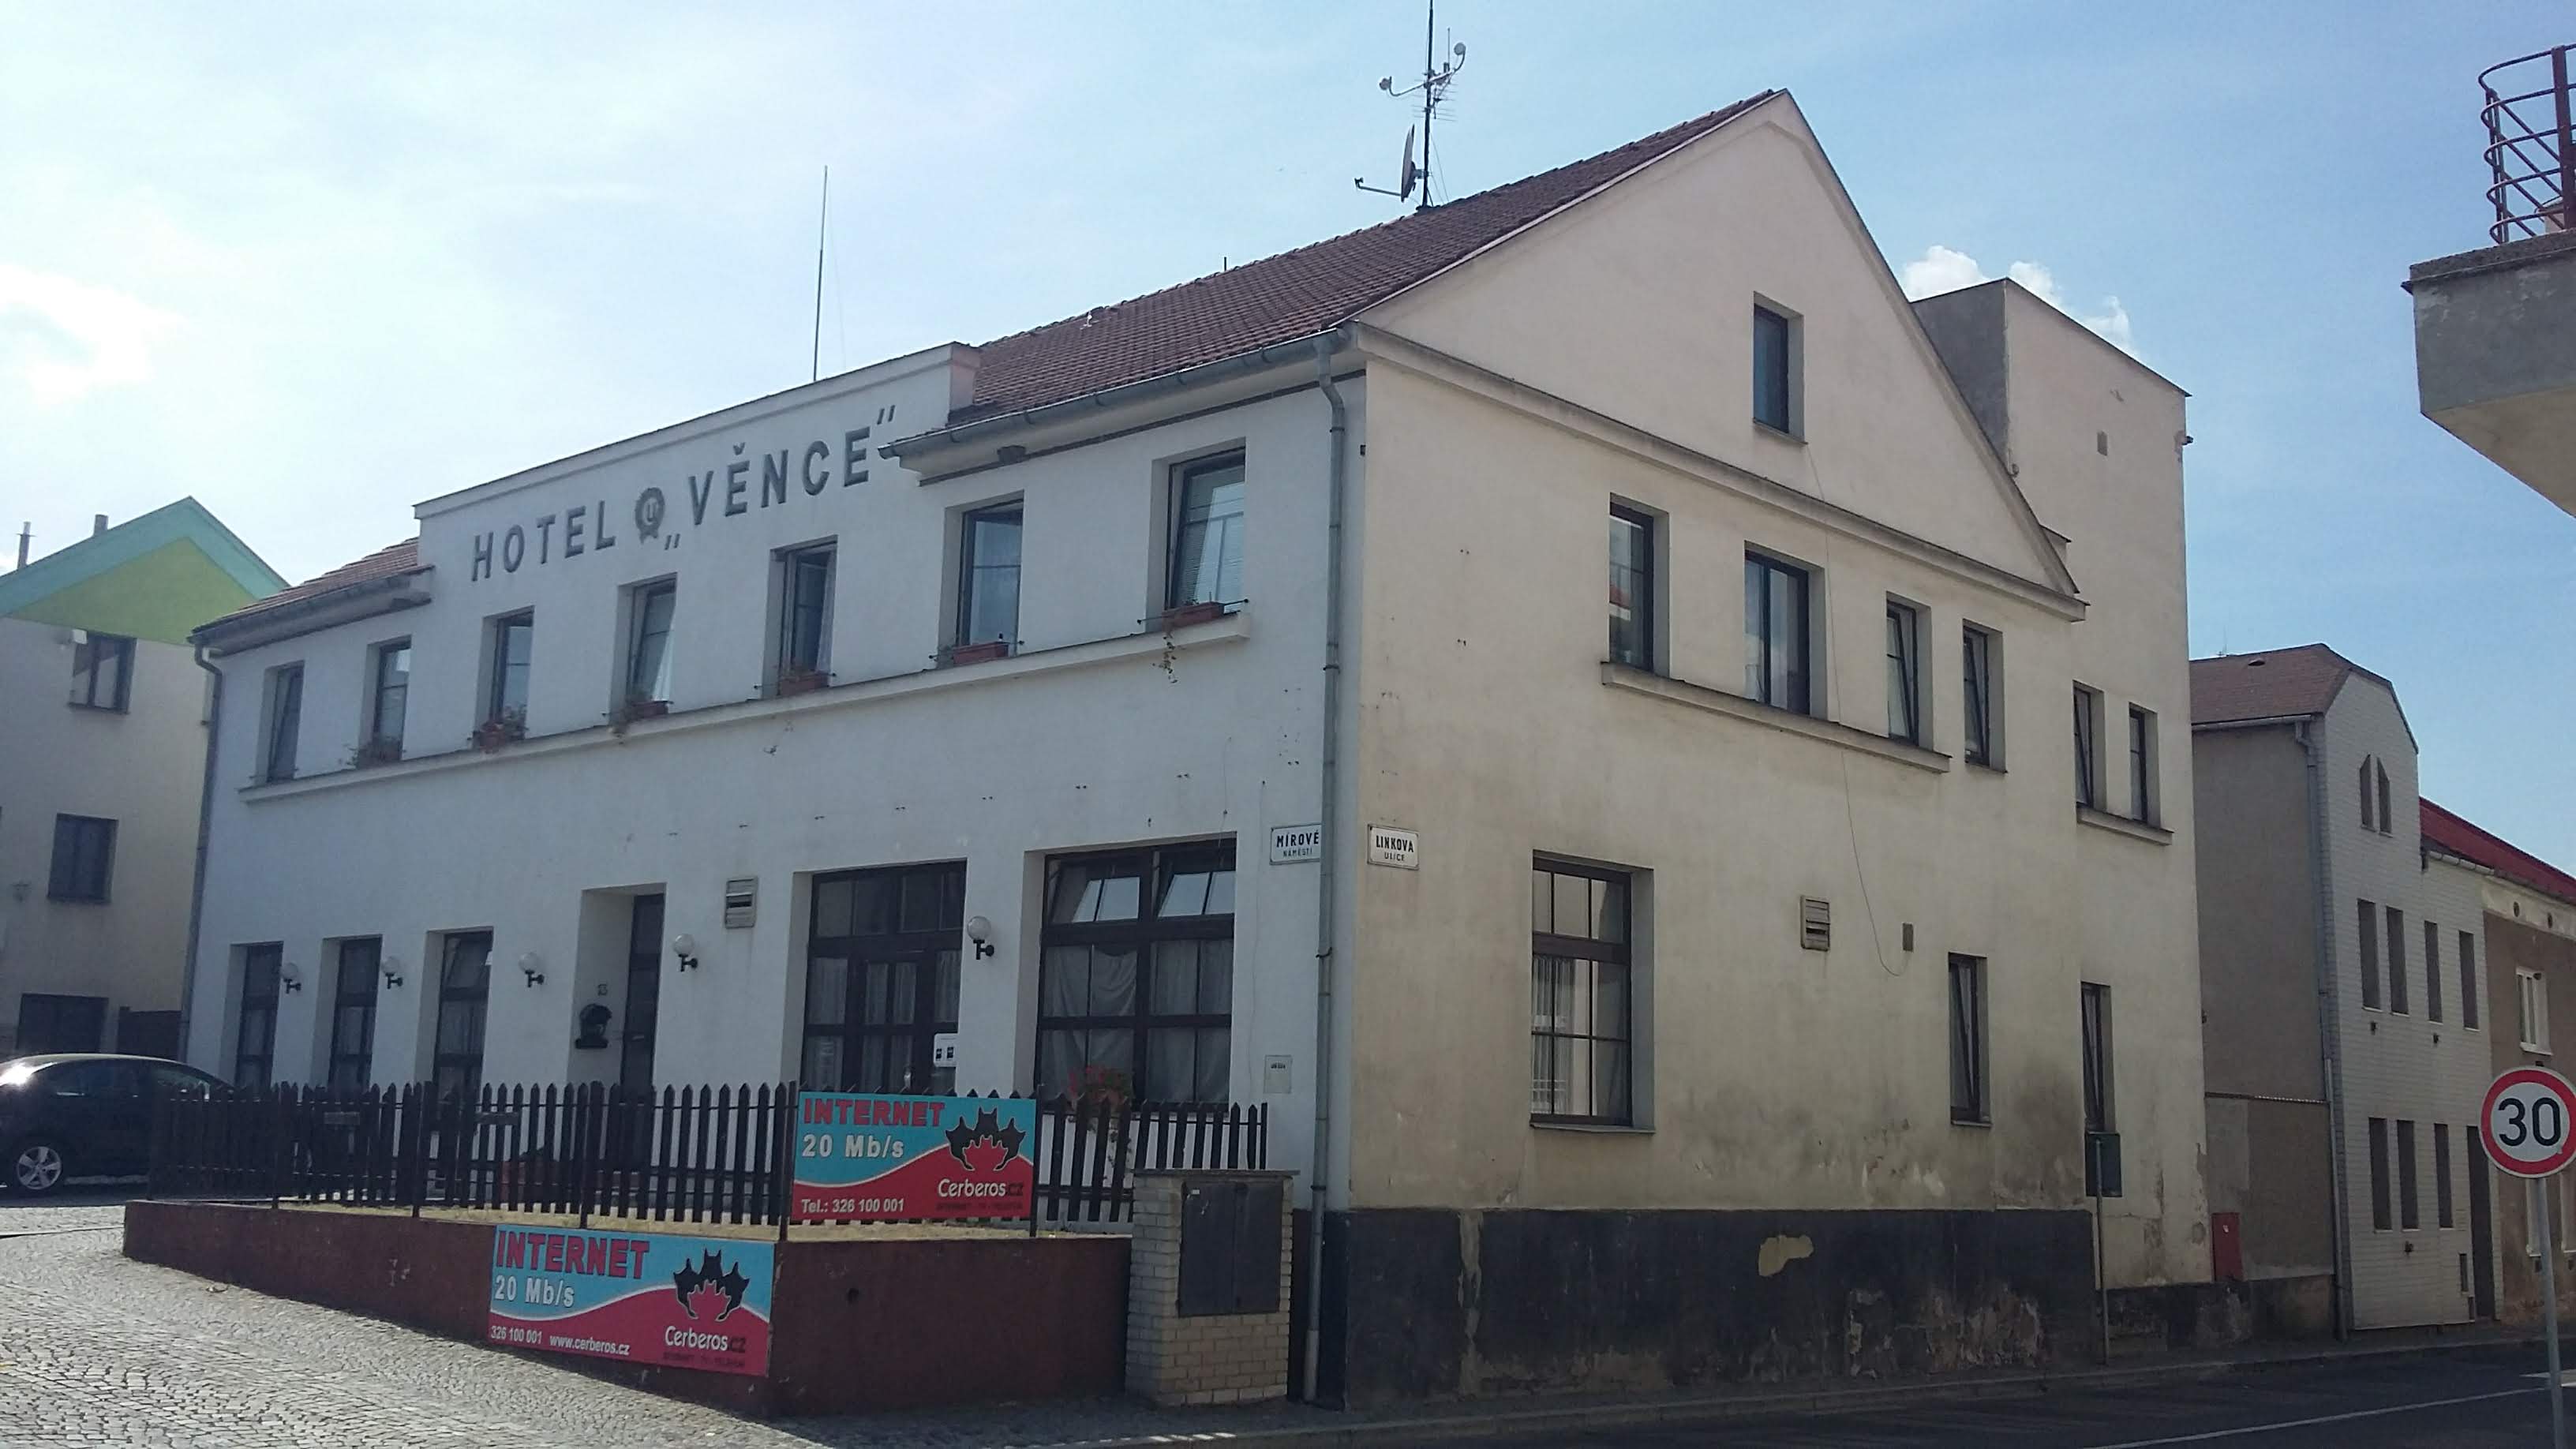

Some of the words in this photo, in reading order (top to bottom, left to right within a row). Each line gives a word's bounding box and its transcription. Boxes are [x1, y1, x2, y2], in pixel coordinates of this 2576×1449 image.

[471, 500, 616, 582] HOTEL
[1276, 831, 1320, 848] MÍROVÉ
[1376, 835, 1414, 852] LINKOVA
[1384, 852, 1405, 861] ULICE
[803, 1098, 946, 1127] INTERNET
[2498, 1097, 2562, 1147] 30
[802, 1134, 833, 1159] 20
[844, 1134, 904, 1159] Mb/s
[801, 1198, 828, 1213] Tel.:
[832, 1199, 856, 1213] 326
[859, 1199, 881, 1212] 100
[883, 1198, 904, 1212] 001
[496, 1230, 650, 1279] INTERNET
[495, 1275, 517, 1301] 20
[526, 1277, 575, 1308] Mb/s
[491, 1325, 507, 1339] 326
[510, 1327, 524, 1342] 100
[526, 1329, 542, 1344] 001
[549, 1335, 631, 1356] www.cerberos.cz
